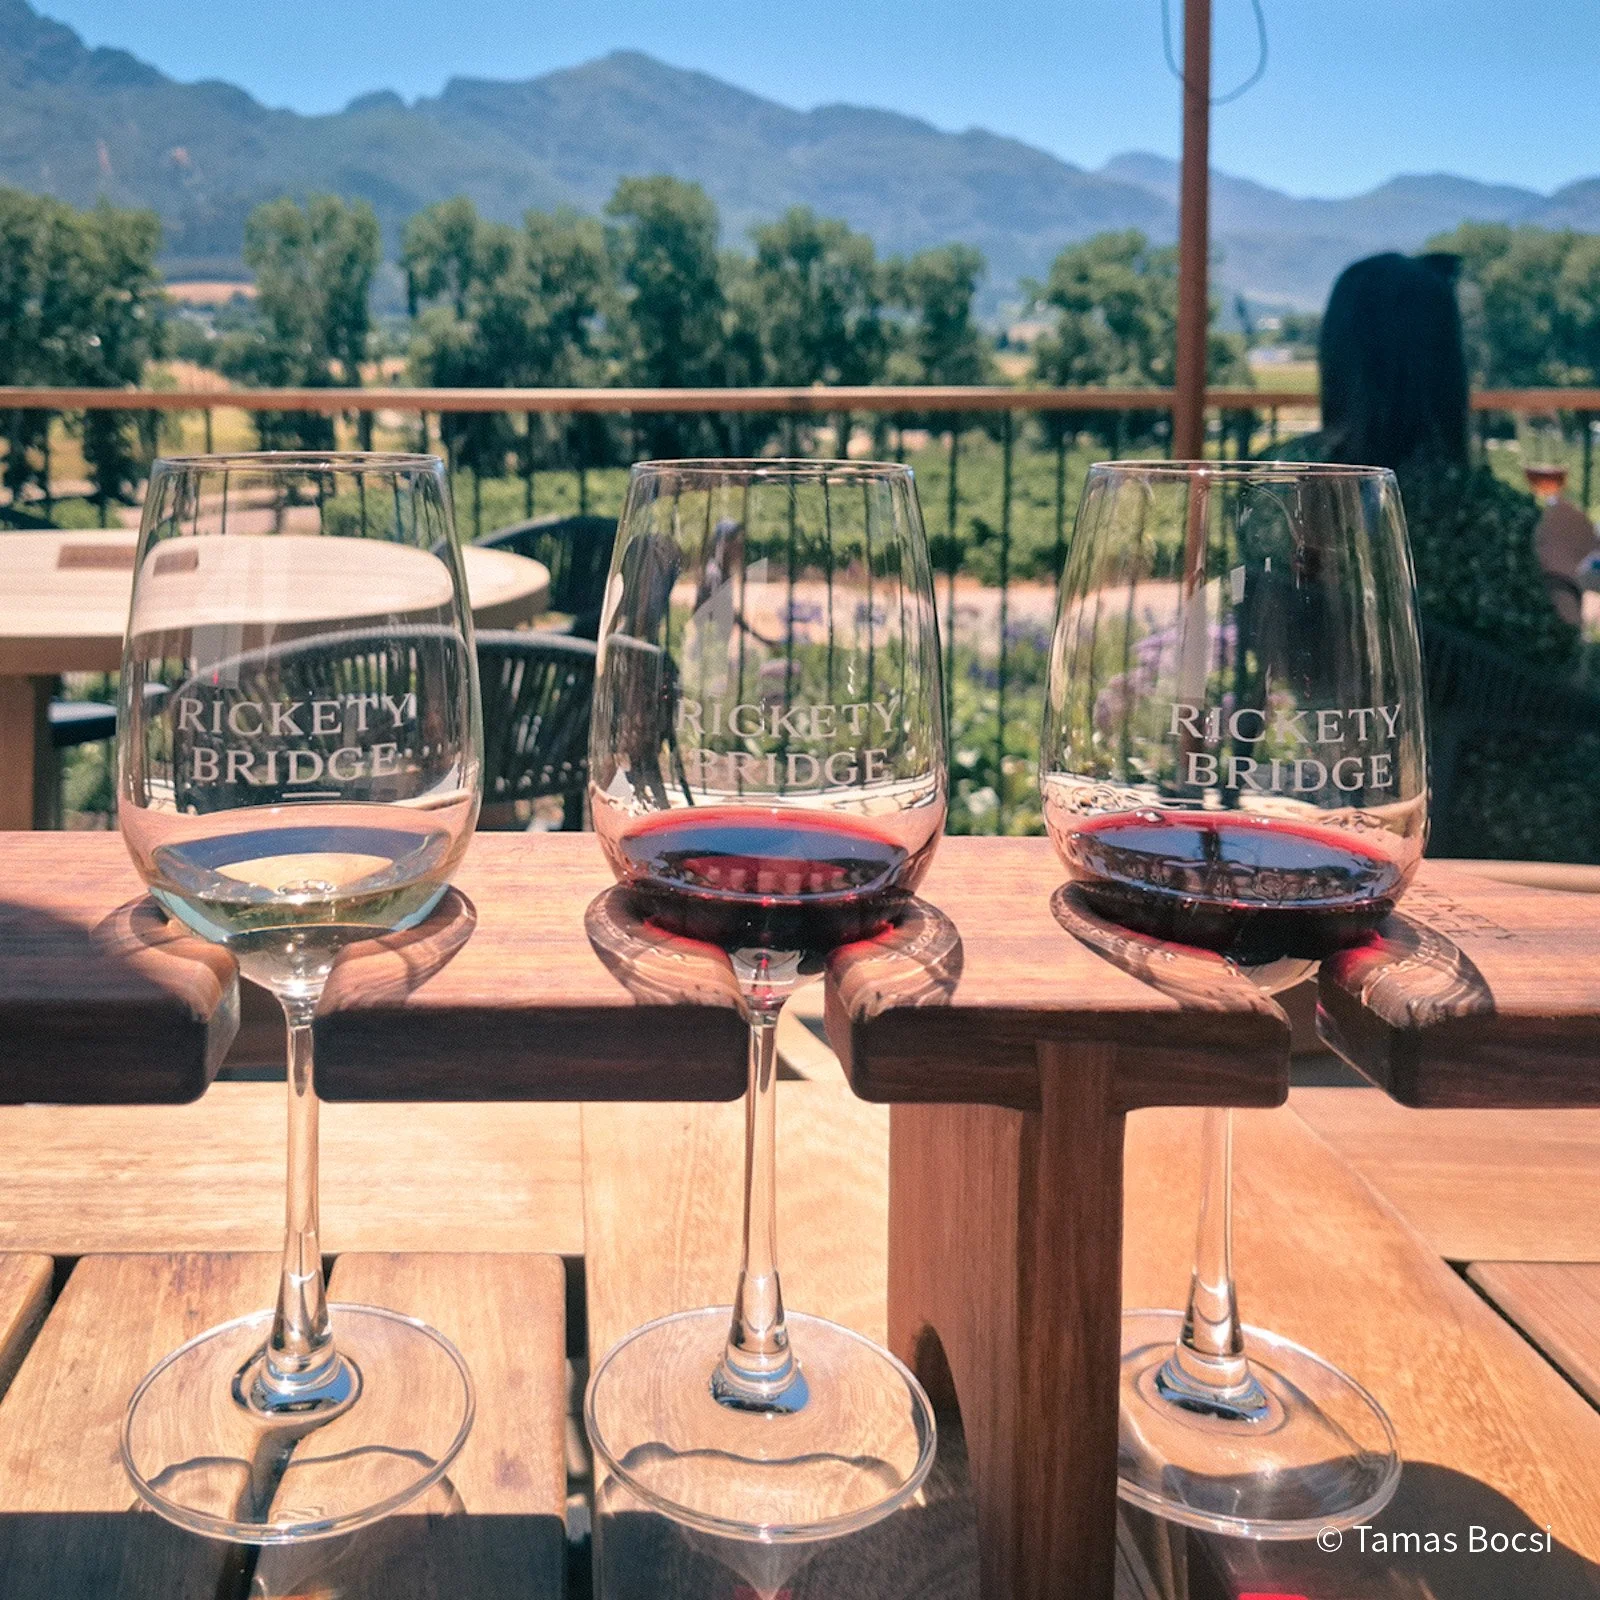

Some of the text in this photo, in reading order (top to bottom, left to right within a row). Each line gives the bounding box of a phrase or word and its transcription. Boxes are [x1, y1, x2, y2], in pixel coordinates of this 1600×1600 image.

[178, 693, 412, 736] RICKETY
[676, 697, 900, 739] RICKETY
[1167, 703, 1401, 744] RICKETY
[190, 742, 399, 785] BRIDGE
[693, 748, 892, 787] BRIDGE
[1185, 751, 1393, 793] BRIDGE
